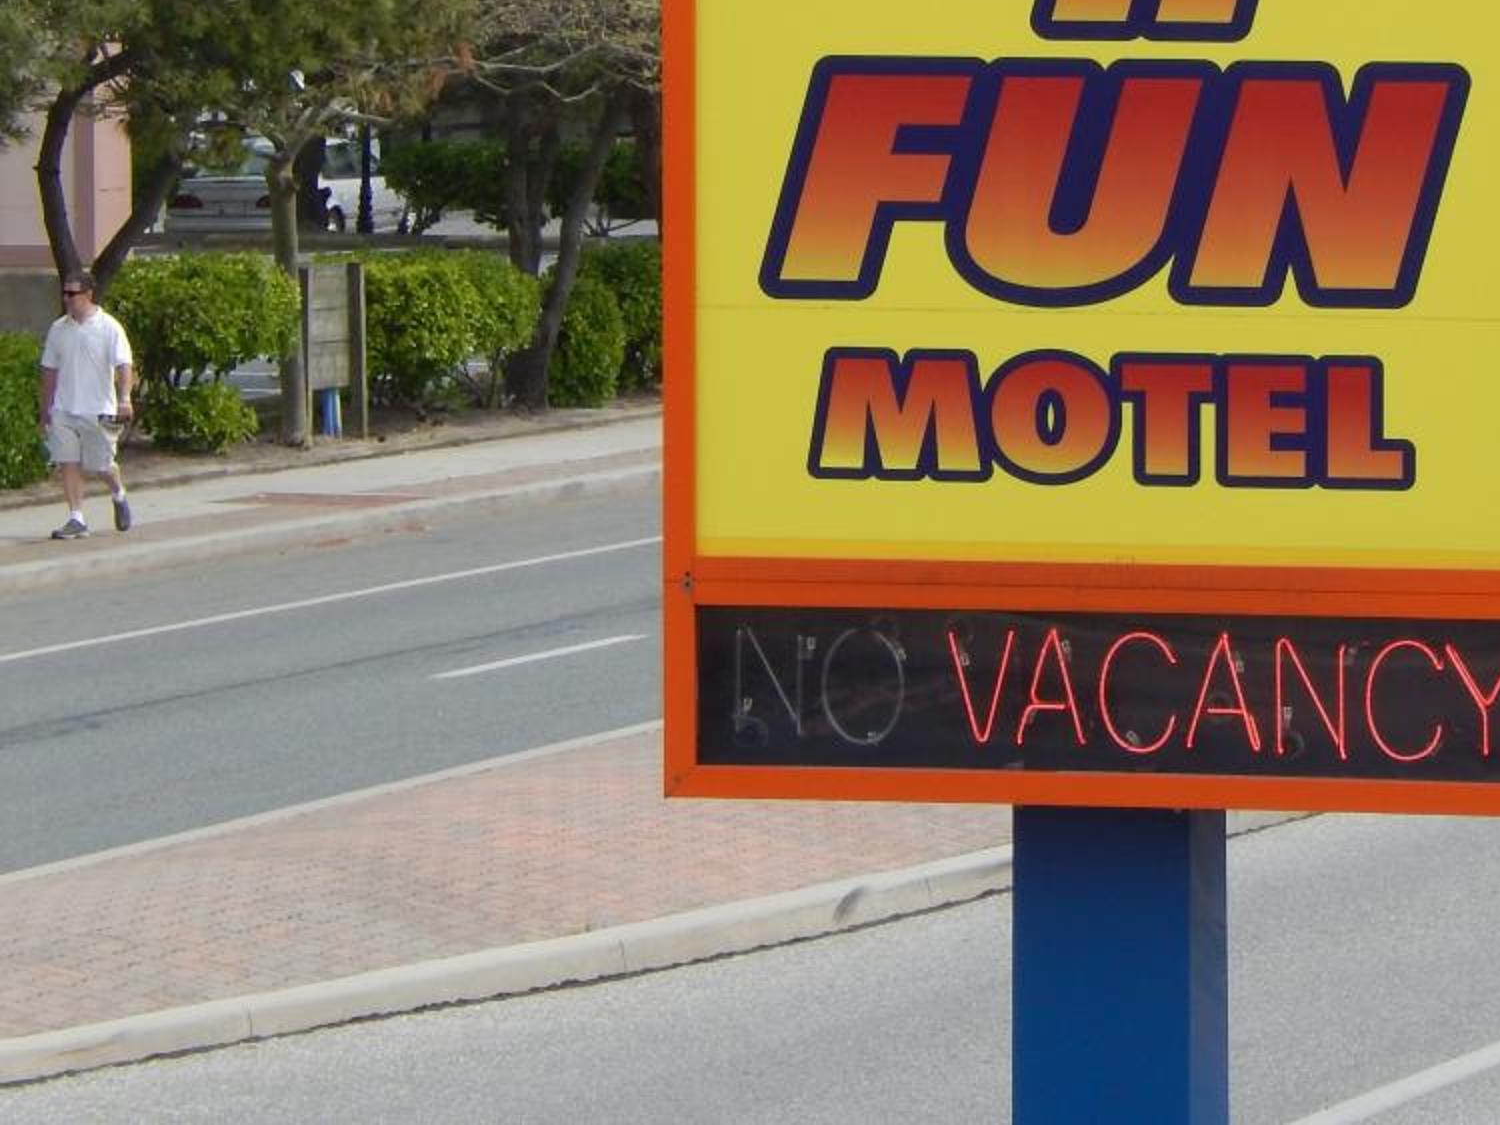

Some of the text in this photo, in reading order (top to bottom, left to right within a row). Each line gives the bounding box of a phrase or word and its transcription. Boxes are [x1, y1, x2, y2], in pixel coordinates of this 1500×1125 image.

[758, 54, 1472, 309] FUN
[806, 346, 1416, 491] MOTEL
[734, 627, 905, 746] NO
